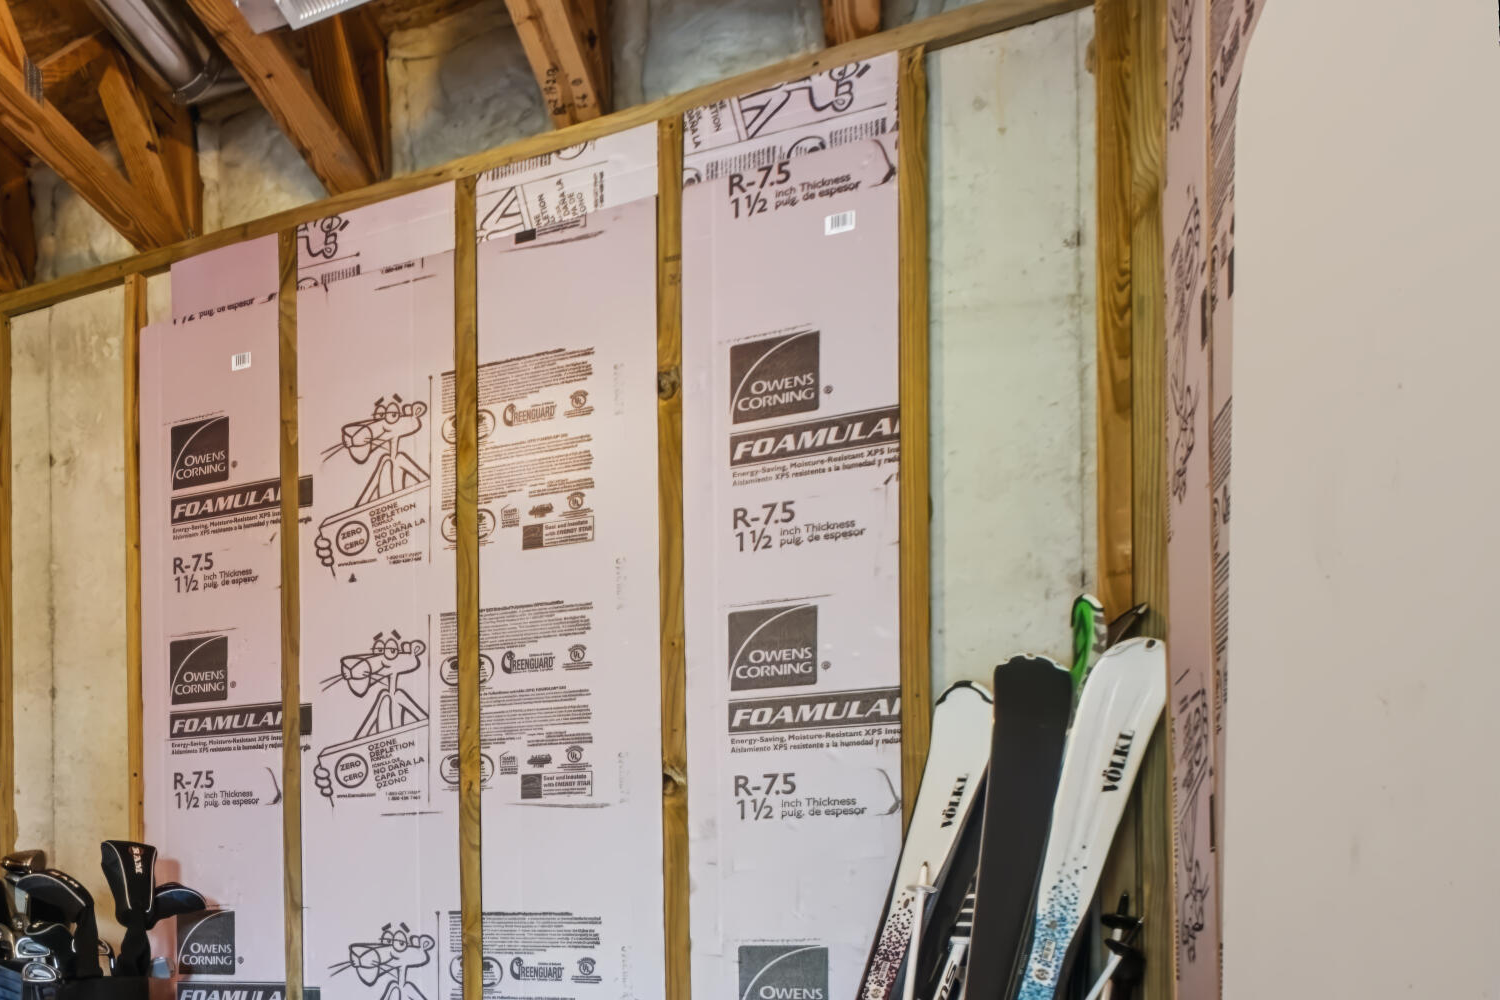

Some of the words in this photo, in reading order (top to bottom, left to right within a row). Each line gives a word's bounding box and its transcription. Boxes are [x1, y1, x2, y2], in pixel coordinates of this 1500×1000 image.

[728, 161, 791, 197] R-7.5
[775, 187, 796, 198] inch
[800, 174, 852, 192] Thickness
[802, 191, 815, 201] de
[819, 180, 862, 198] espesor
[750, 373, 815, 395] OWENS
[737, 387, 815, 412] CORNING
[184, 450, 226, 467] OWENS
[867, 448, 885, 456] XPS
[175, 463, 226, 480] CORNING
[369, 501, 398, 517] OZONE
[370, 502, 416, 524] DEPLETION
[733, 500, 795, 530] R-7.5
[341, 527, 362, 540] ZERO
[374, 531, 388, 541] NO
[389, 522, 412, 536] DAÑA
[414, 518, 426, 526] LA
[780, 524, 801, 536] inch
[804, 519, 856, 533] Thickness
[807, 531, 820, 542] de
[823, 528, 867, 542] espesor
[343, 538, 365, 551] CERO
[376, 535, 398, 547] CAPA
[400, 530, 409, 539] DE
[377, 539, 408, 554] OZONO
[173, 552, 214, 575] R-7.5
[203, 572, 217, 582] inch
[219, 568, 252, 579] Thickness
[221, 578, 230, 586] de
[231, 574, 259, 586] espesor
[749, 646, 813, 664] OWENS
[183, 669, 225, 683] OWENS
[735, 662, 813, 679] CORNING
[174, 682, 225, 696] CORNING
[788, 730, 862, 741] Moisture-Resistant
[840, 737, 874, 748] humedad
[368, 738, 397, 751] OZONE
[369, 741, 415, 758] DEPLETION
[340, 760, 361, 771] ZERO
[373, 767, 386, 775] NO
[388, 760, 412, 772] DAÑA
[413, 756, 425, 765] LA
[1101, 730, 1135, 792] VÖLKL
[173, 770, 214, 790] R-7.5
[343, 772, 364, 783] CERO
[375, 772, 396, 782] CAPA
[398, 768, 409, 776] DE
[376, 776, 407, 789] OZONO
[734, 773, 796, 797] R-7.5
[204, 790, 217, 799] inch
[220, 789, 253, 798] Thickness
[940, 773, 969, 829] VÖLKL
[232, 797, 260, 807] espesor
[781, 799, 802, 808] inch
[805, 797, 857, 807] Thickness
[808, 808, 822, 816] de
[824, 807, 867, 817] espesor
[190, 942, 232, 954] OWENS
[182, 954, 232, 966] CORNING
[759, 985, 823, 1000] OWENS
